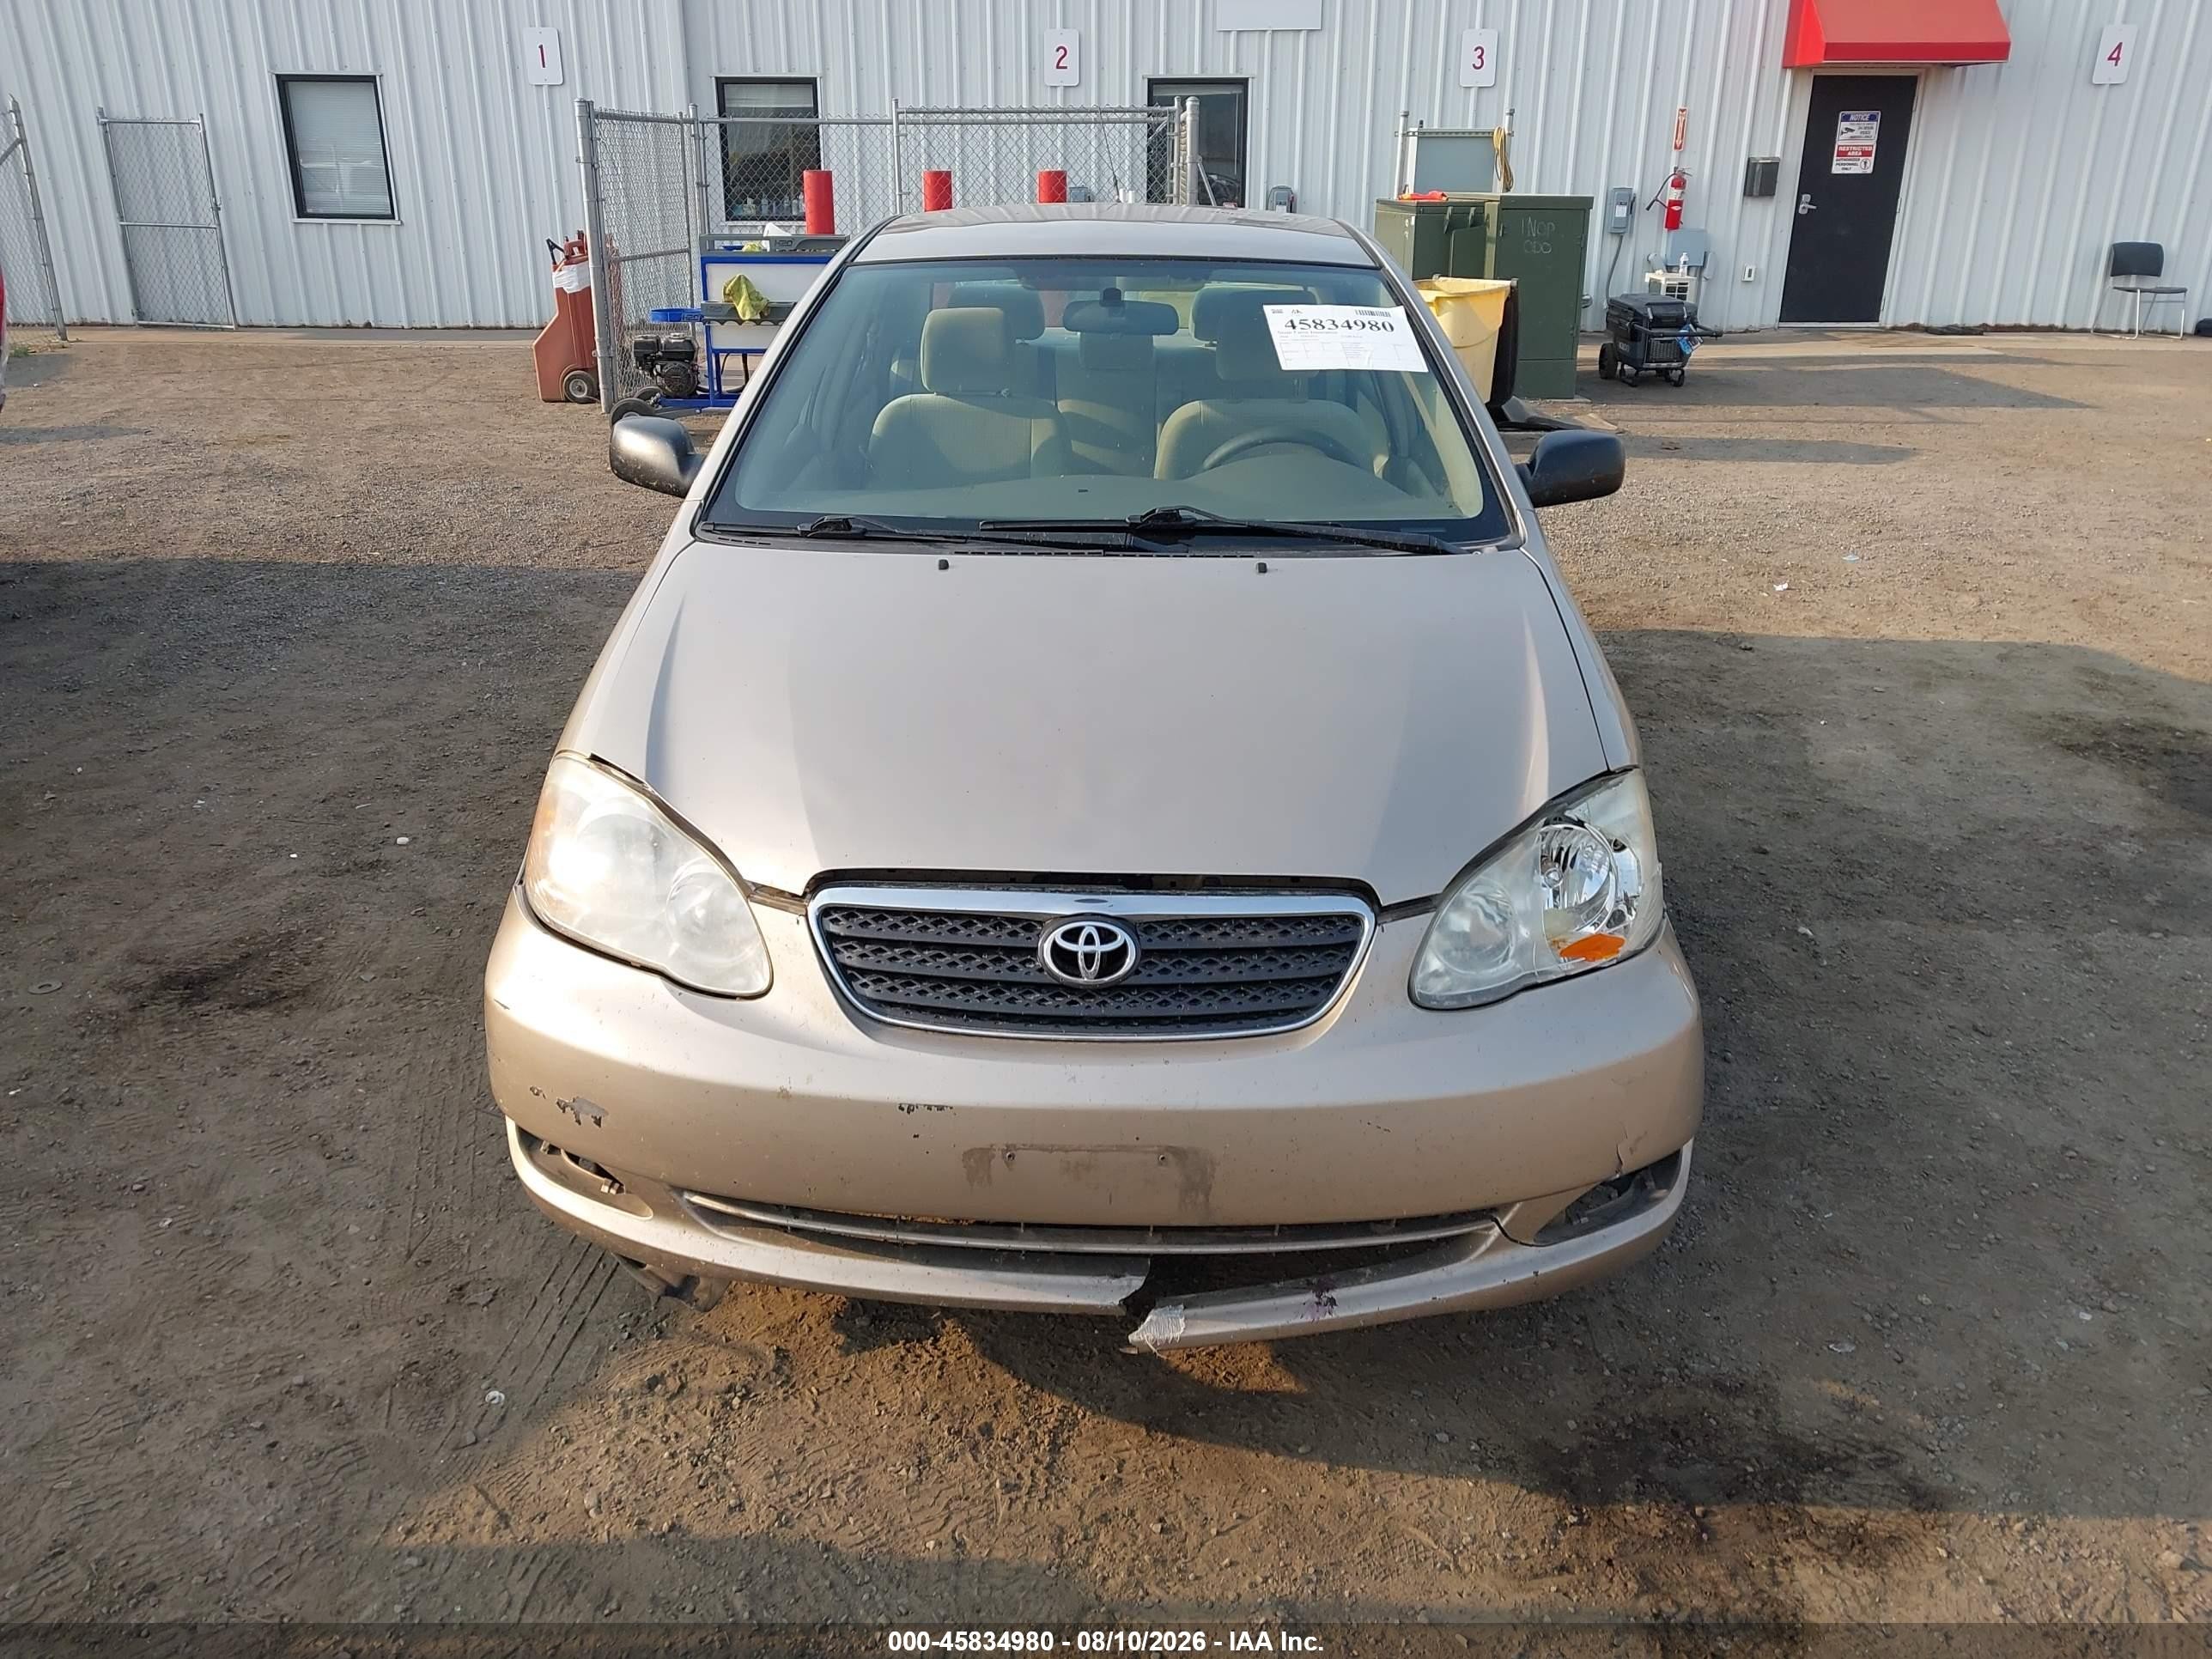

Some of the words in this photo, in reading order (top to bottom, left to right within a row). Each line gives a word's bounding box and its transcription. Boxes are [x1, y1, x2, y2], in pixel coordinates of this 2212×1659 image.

[538, 44, 546, 69] 1
[1055, 46, 1068, 70] 2
[1472, 46, 1485, 70] 3
[2107, 41, 2123, 67] 4
[1284, 318, 1395, 333] 45834980
